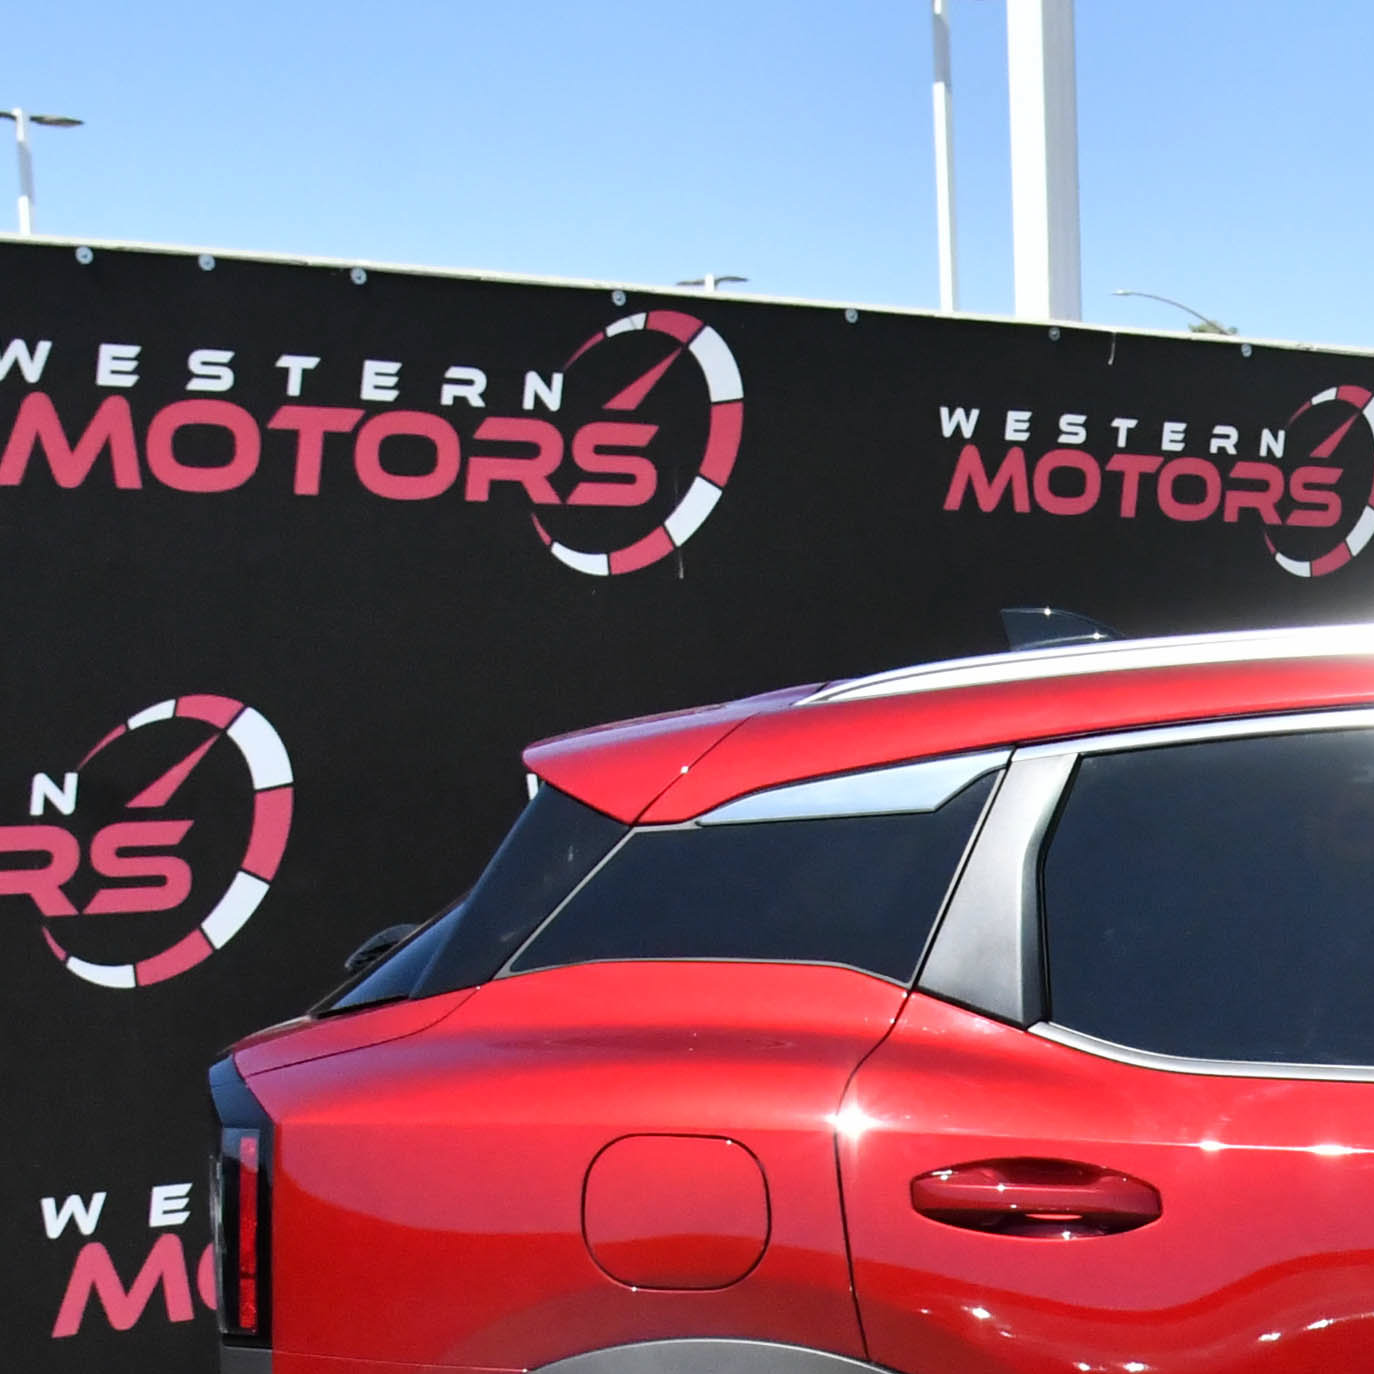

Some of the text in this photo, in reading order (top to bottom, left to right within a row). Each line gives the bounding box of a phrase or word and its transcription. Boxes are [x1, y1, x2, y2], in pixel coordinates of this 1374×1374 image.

[0, 339, 563, 411] WESTERN
[0, 392, 657, 506] MOTORS
[941, 407, 1285, 457] WESTERN
[944, 445, 1341, 525] MOTORS
[42, 1184, 193, 1238] WE
[53, 1234, 218, 1337] M
